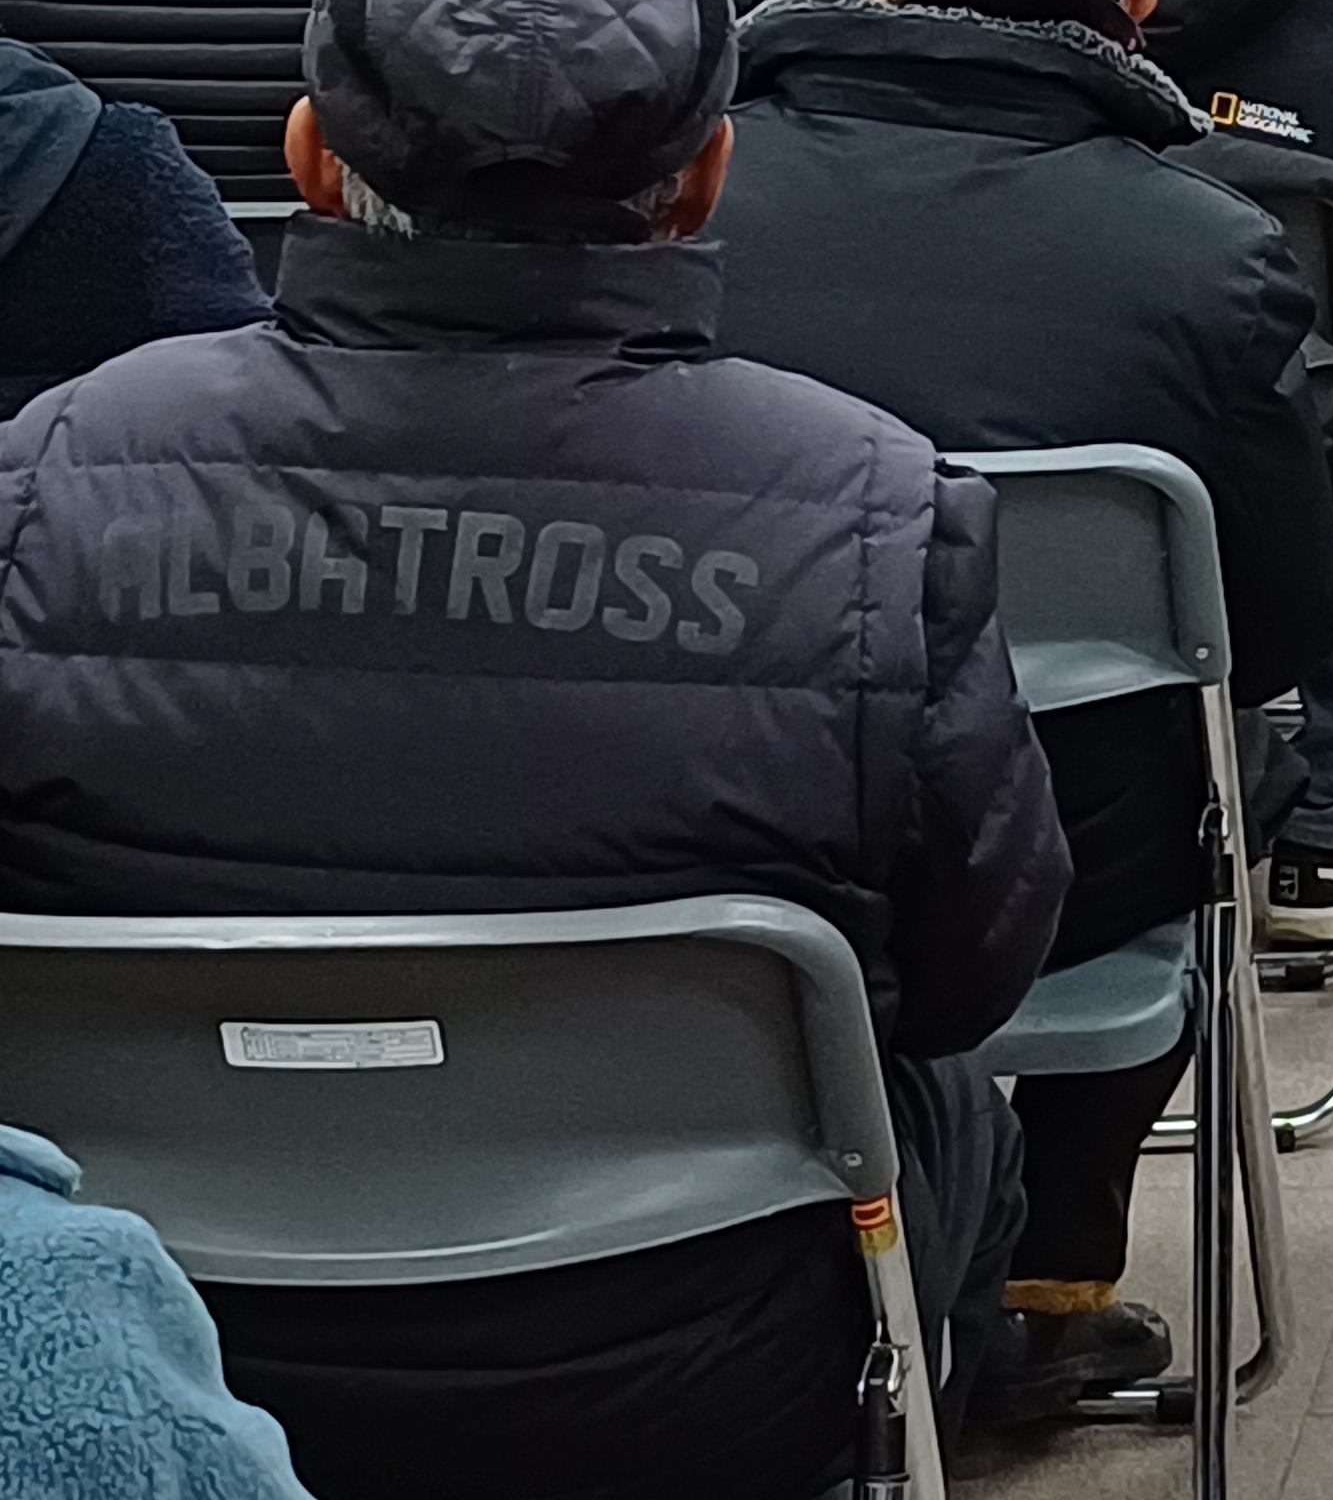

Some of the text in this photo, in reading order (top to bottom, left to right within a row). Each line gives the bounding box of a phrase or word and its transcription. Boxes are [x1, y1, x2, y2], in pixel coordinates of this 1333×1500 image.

[1239, 100, 1300, 126] NATIONAL
[1236, 115, 1316, 144] GEOGRAPHIC
[99, 505, 760, 655] ALBATROSS
